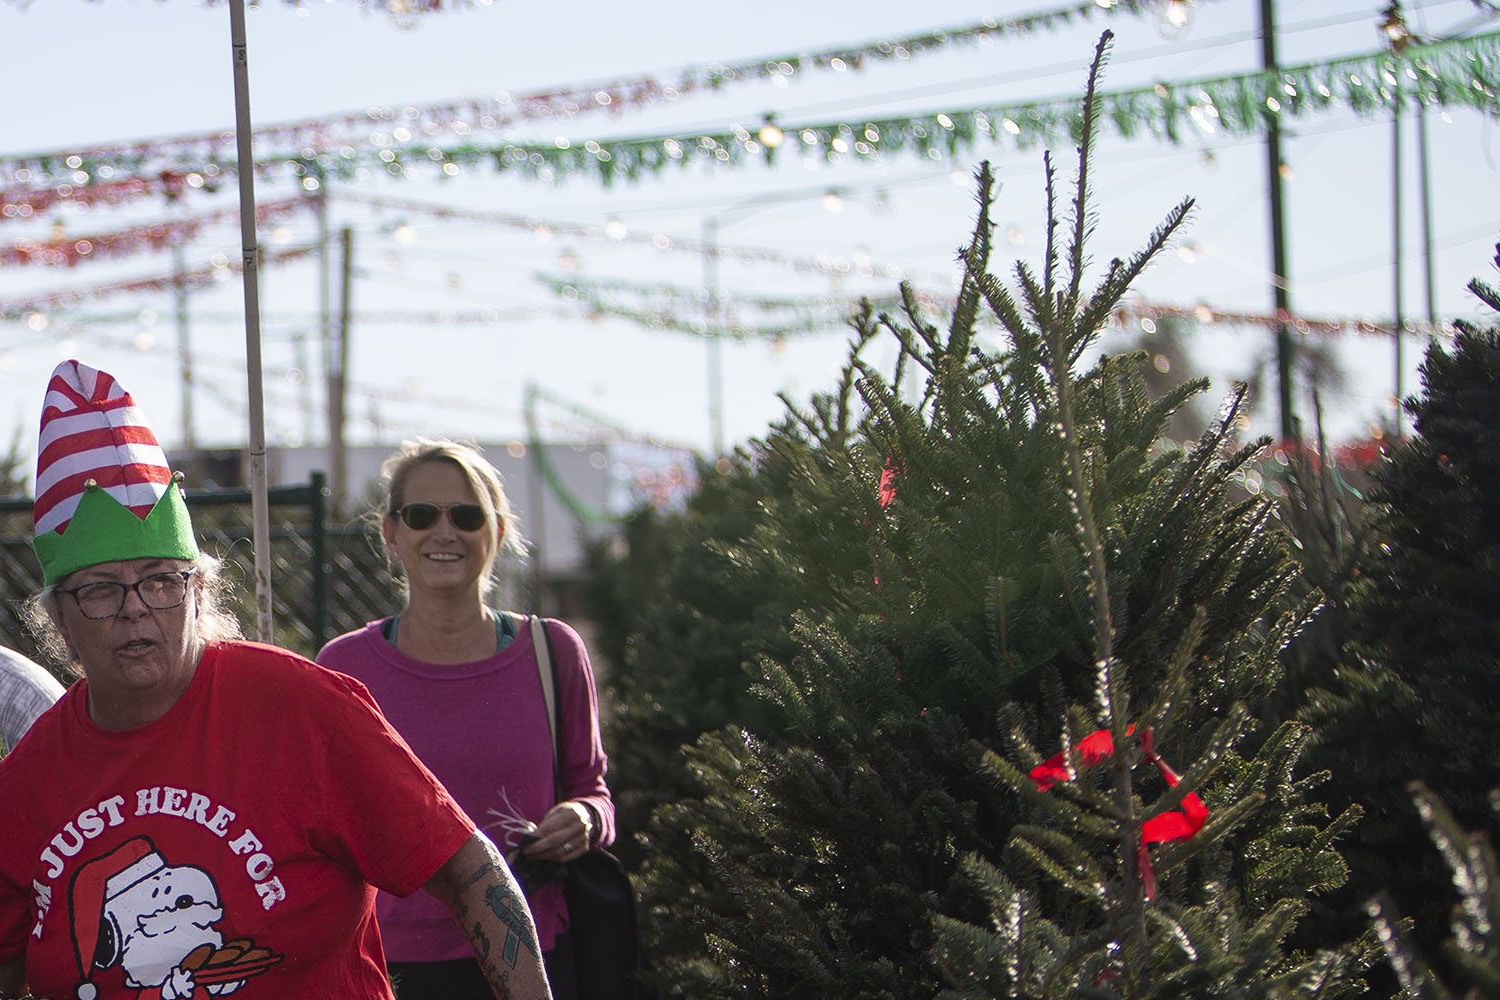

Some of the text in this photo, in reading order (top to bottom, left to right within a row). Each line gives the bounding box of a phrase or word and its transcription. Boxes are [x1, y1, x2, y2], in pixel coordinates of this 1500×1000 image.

[40, 795, 125, 879] JUST
[134, 786, 236, 838] HERE
[228, 828, 286, 911] FOR
